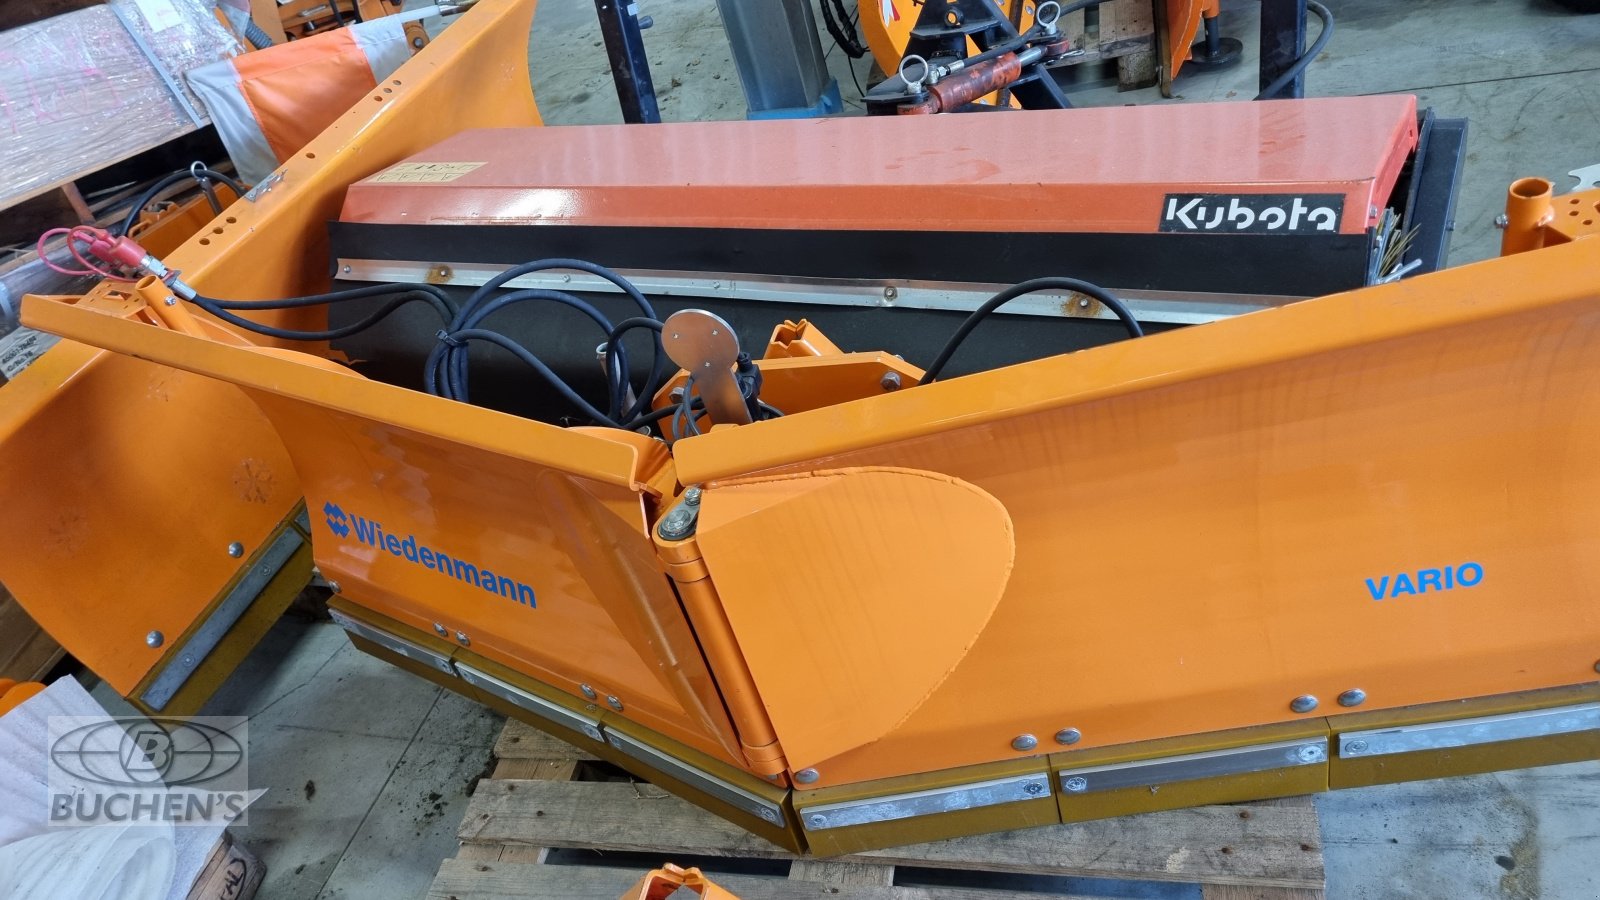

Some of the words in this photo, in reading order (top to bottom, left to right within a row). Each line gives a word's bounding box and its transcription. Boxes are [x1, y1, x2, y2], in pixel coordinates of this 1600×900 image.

[1166, 198, 1337, 230] Kubota
[349, 513, 537, 608] Wiedenmann
[1365, 562, 1483, 600] VARIO
